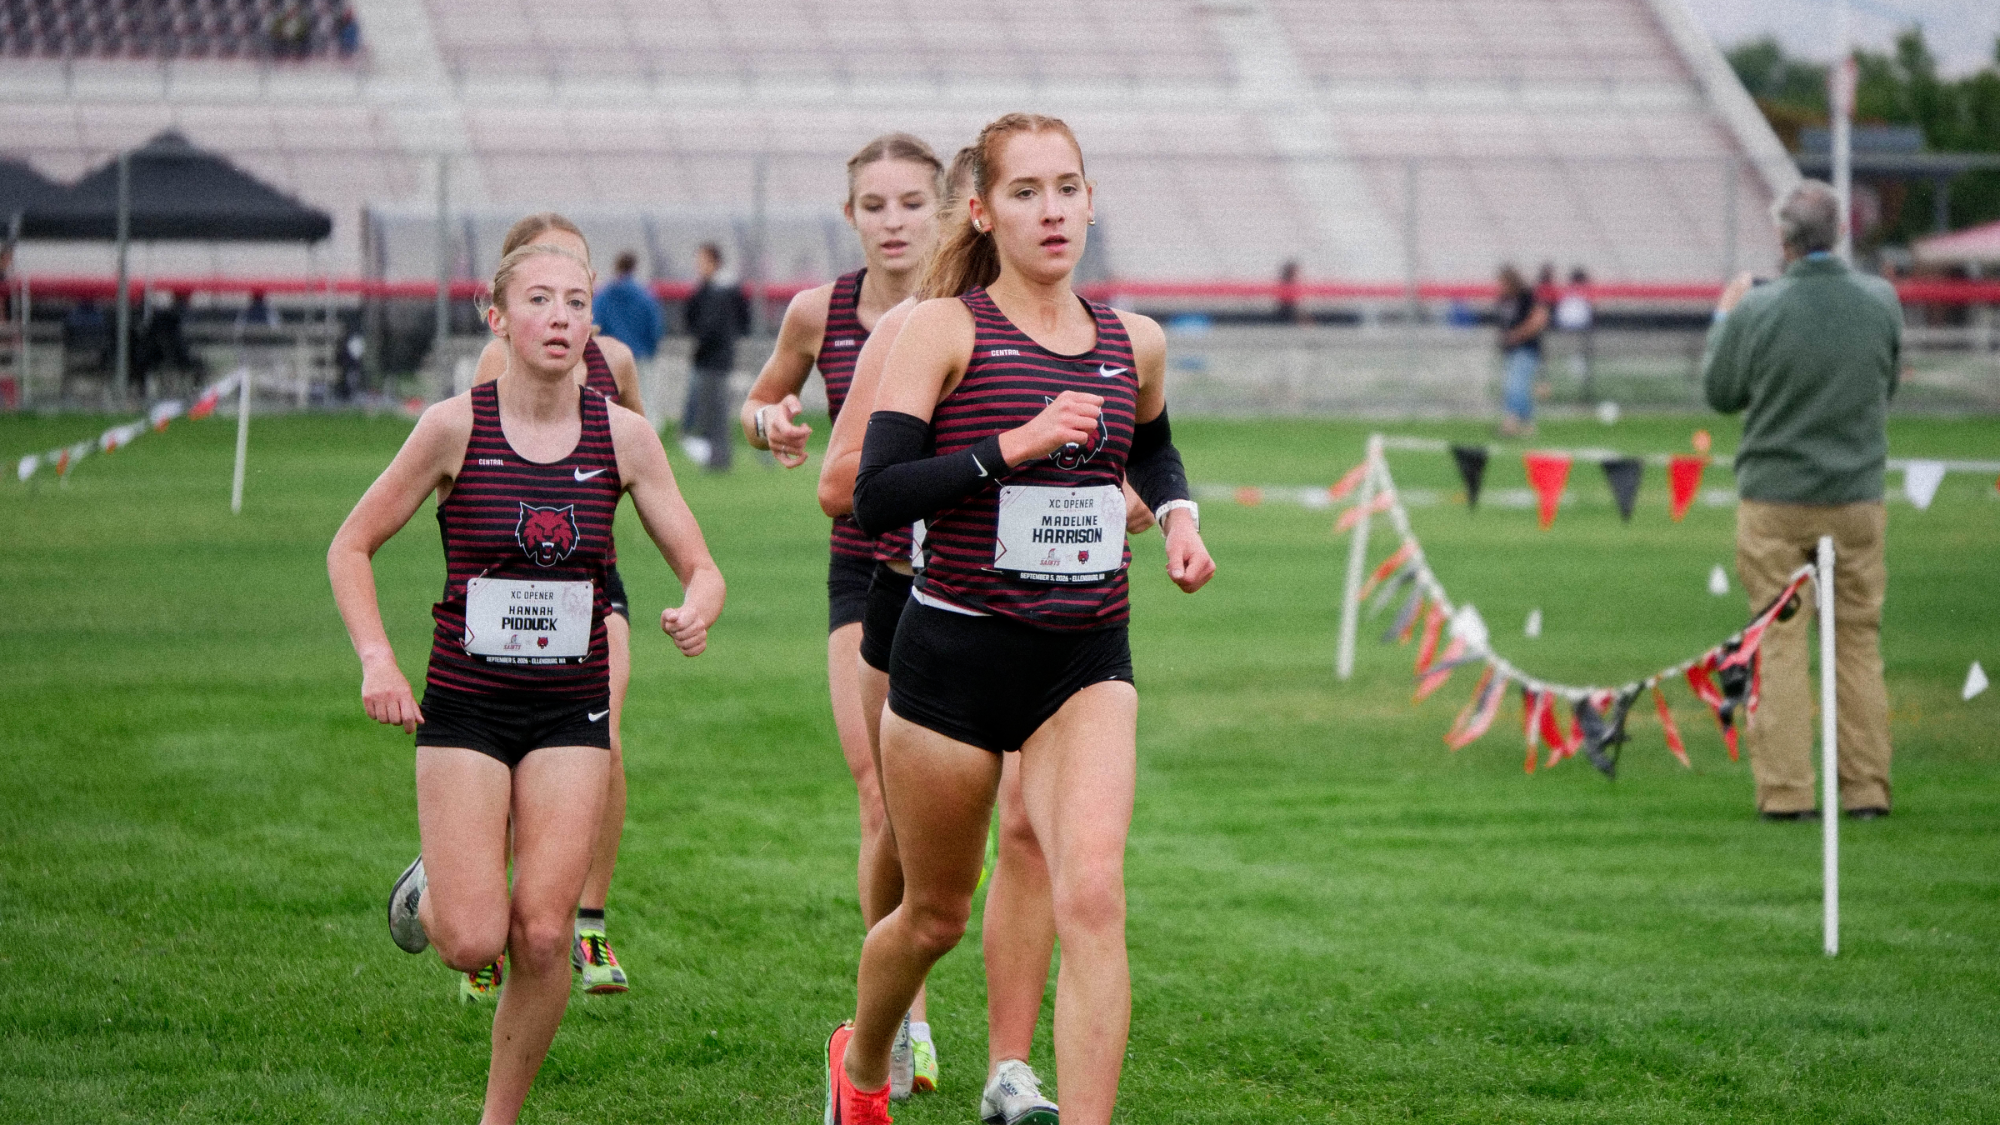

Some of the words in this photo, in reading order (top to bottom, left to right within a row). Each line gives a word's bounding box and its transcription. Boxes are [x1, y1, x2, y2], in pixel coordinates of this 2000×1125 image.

[990, 348, 1021, 357] CENTRAL
[478, 458, 504, 466] CENTRAL
[1049, 498, 1061, 508] XC
[1063, 498, 1094, 508] OPENER
[1041, 515, 1098, 526] MADELINE
[1032, 527, 1103, 543] HARRISON
[1020, 572, 1049, 581] SEPTEMBER
[511, 590, 522, 600] XC
[524, 591, 554, 600] OPENER
[508, 605, 553, 616] HANNAH
[501, 617, 558, 631] PIDDUCK
